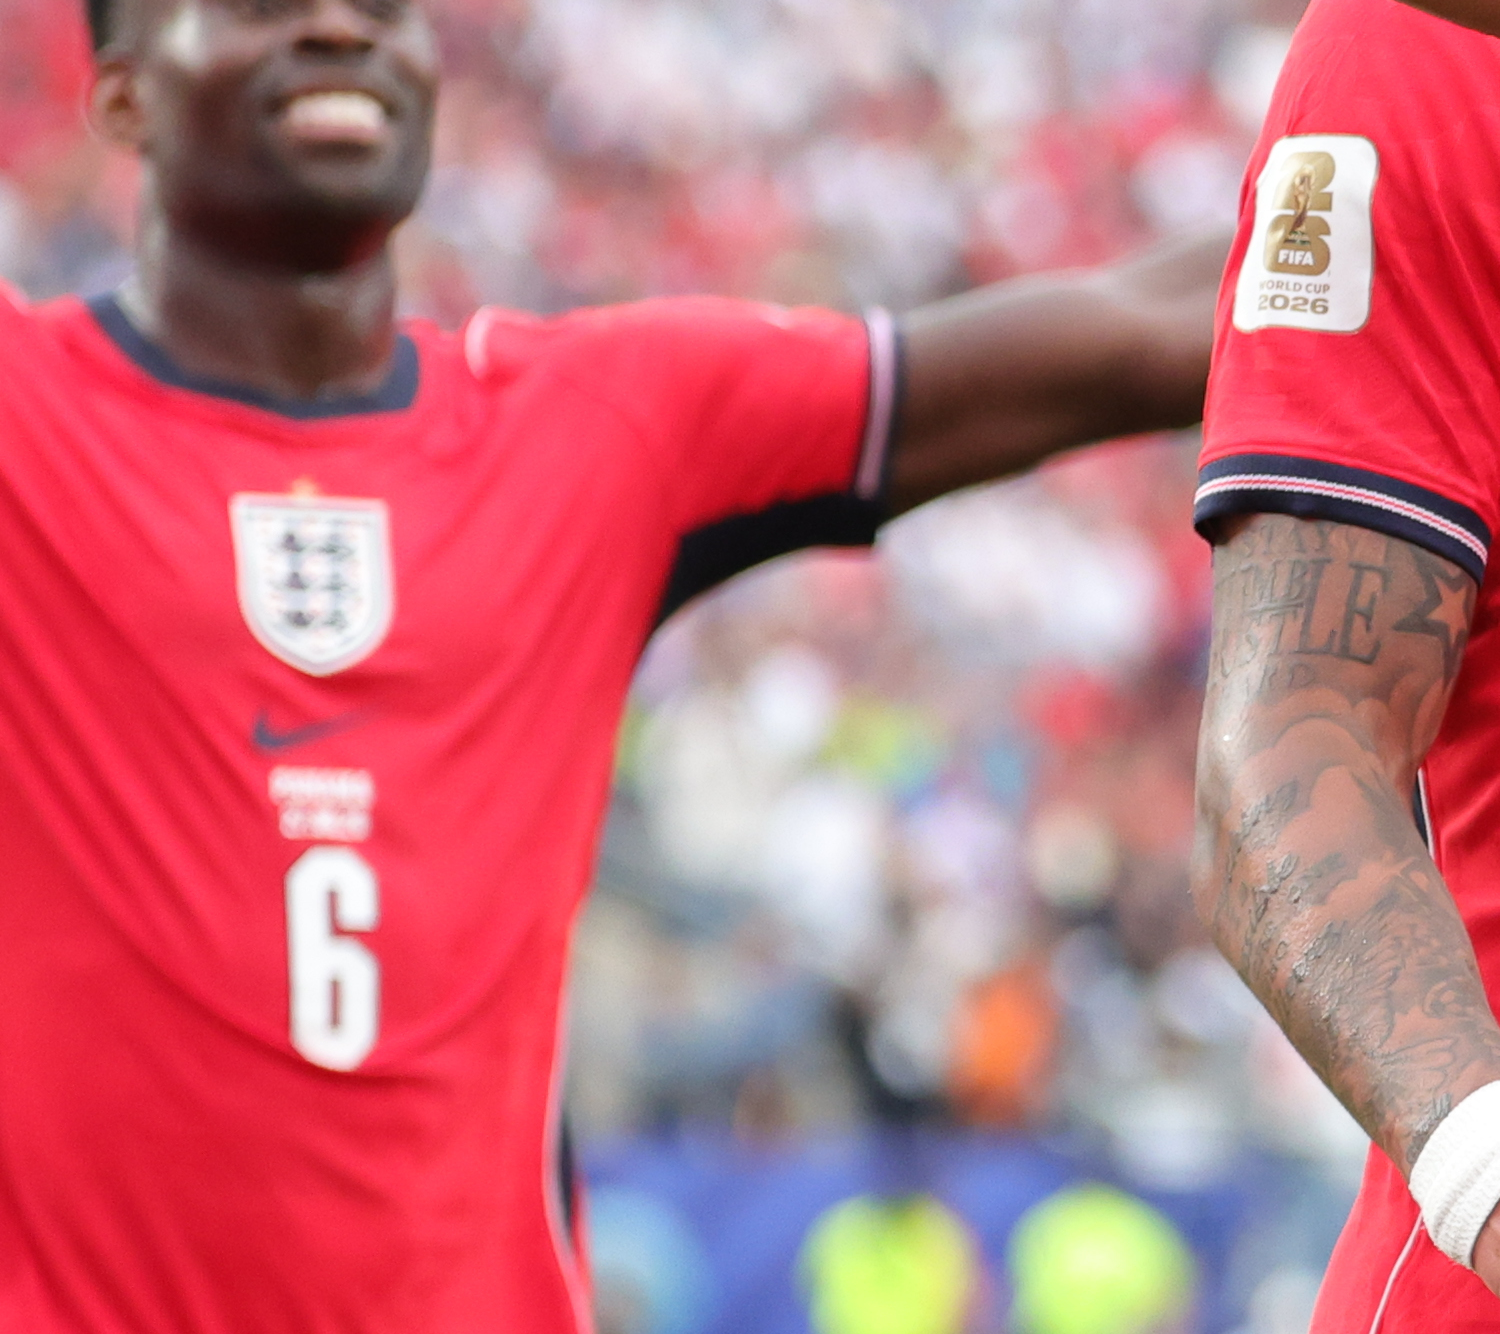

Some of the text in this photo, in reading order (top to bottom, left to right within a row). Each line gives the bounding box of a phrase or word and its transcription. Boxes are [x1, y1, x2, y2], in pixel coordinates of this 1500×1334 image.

[1277, 249, 1315, 266] FIFA
[1305, 283, 1331, 294] CUP
[1257, 294, 1330, 315] 2026
[284, 843, 382, 1072] 6
